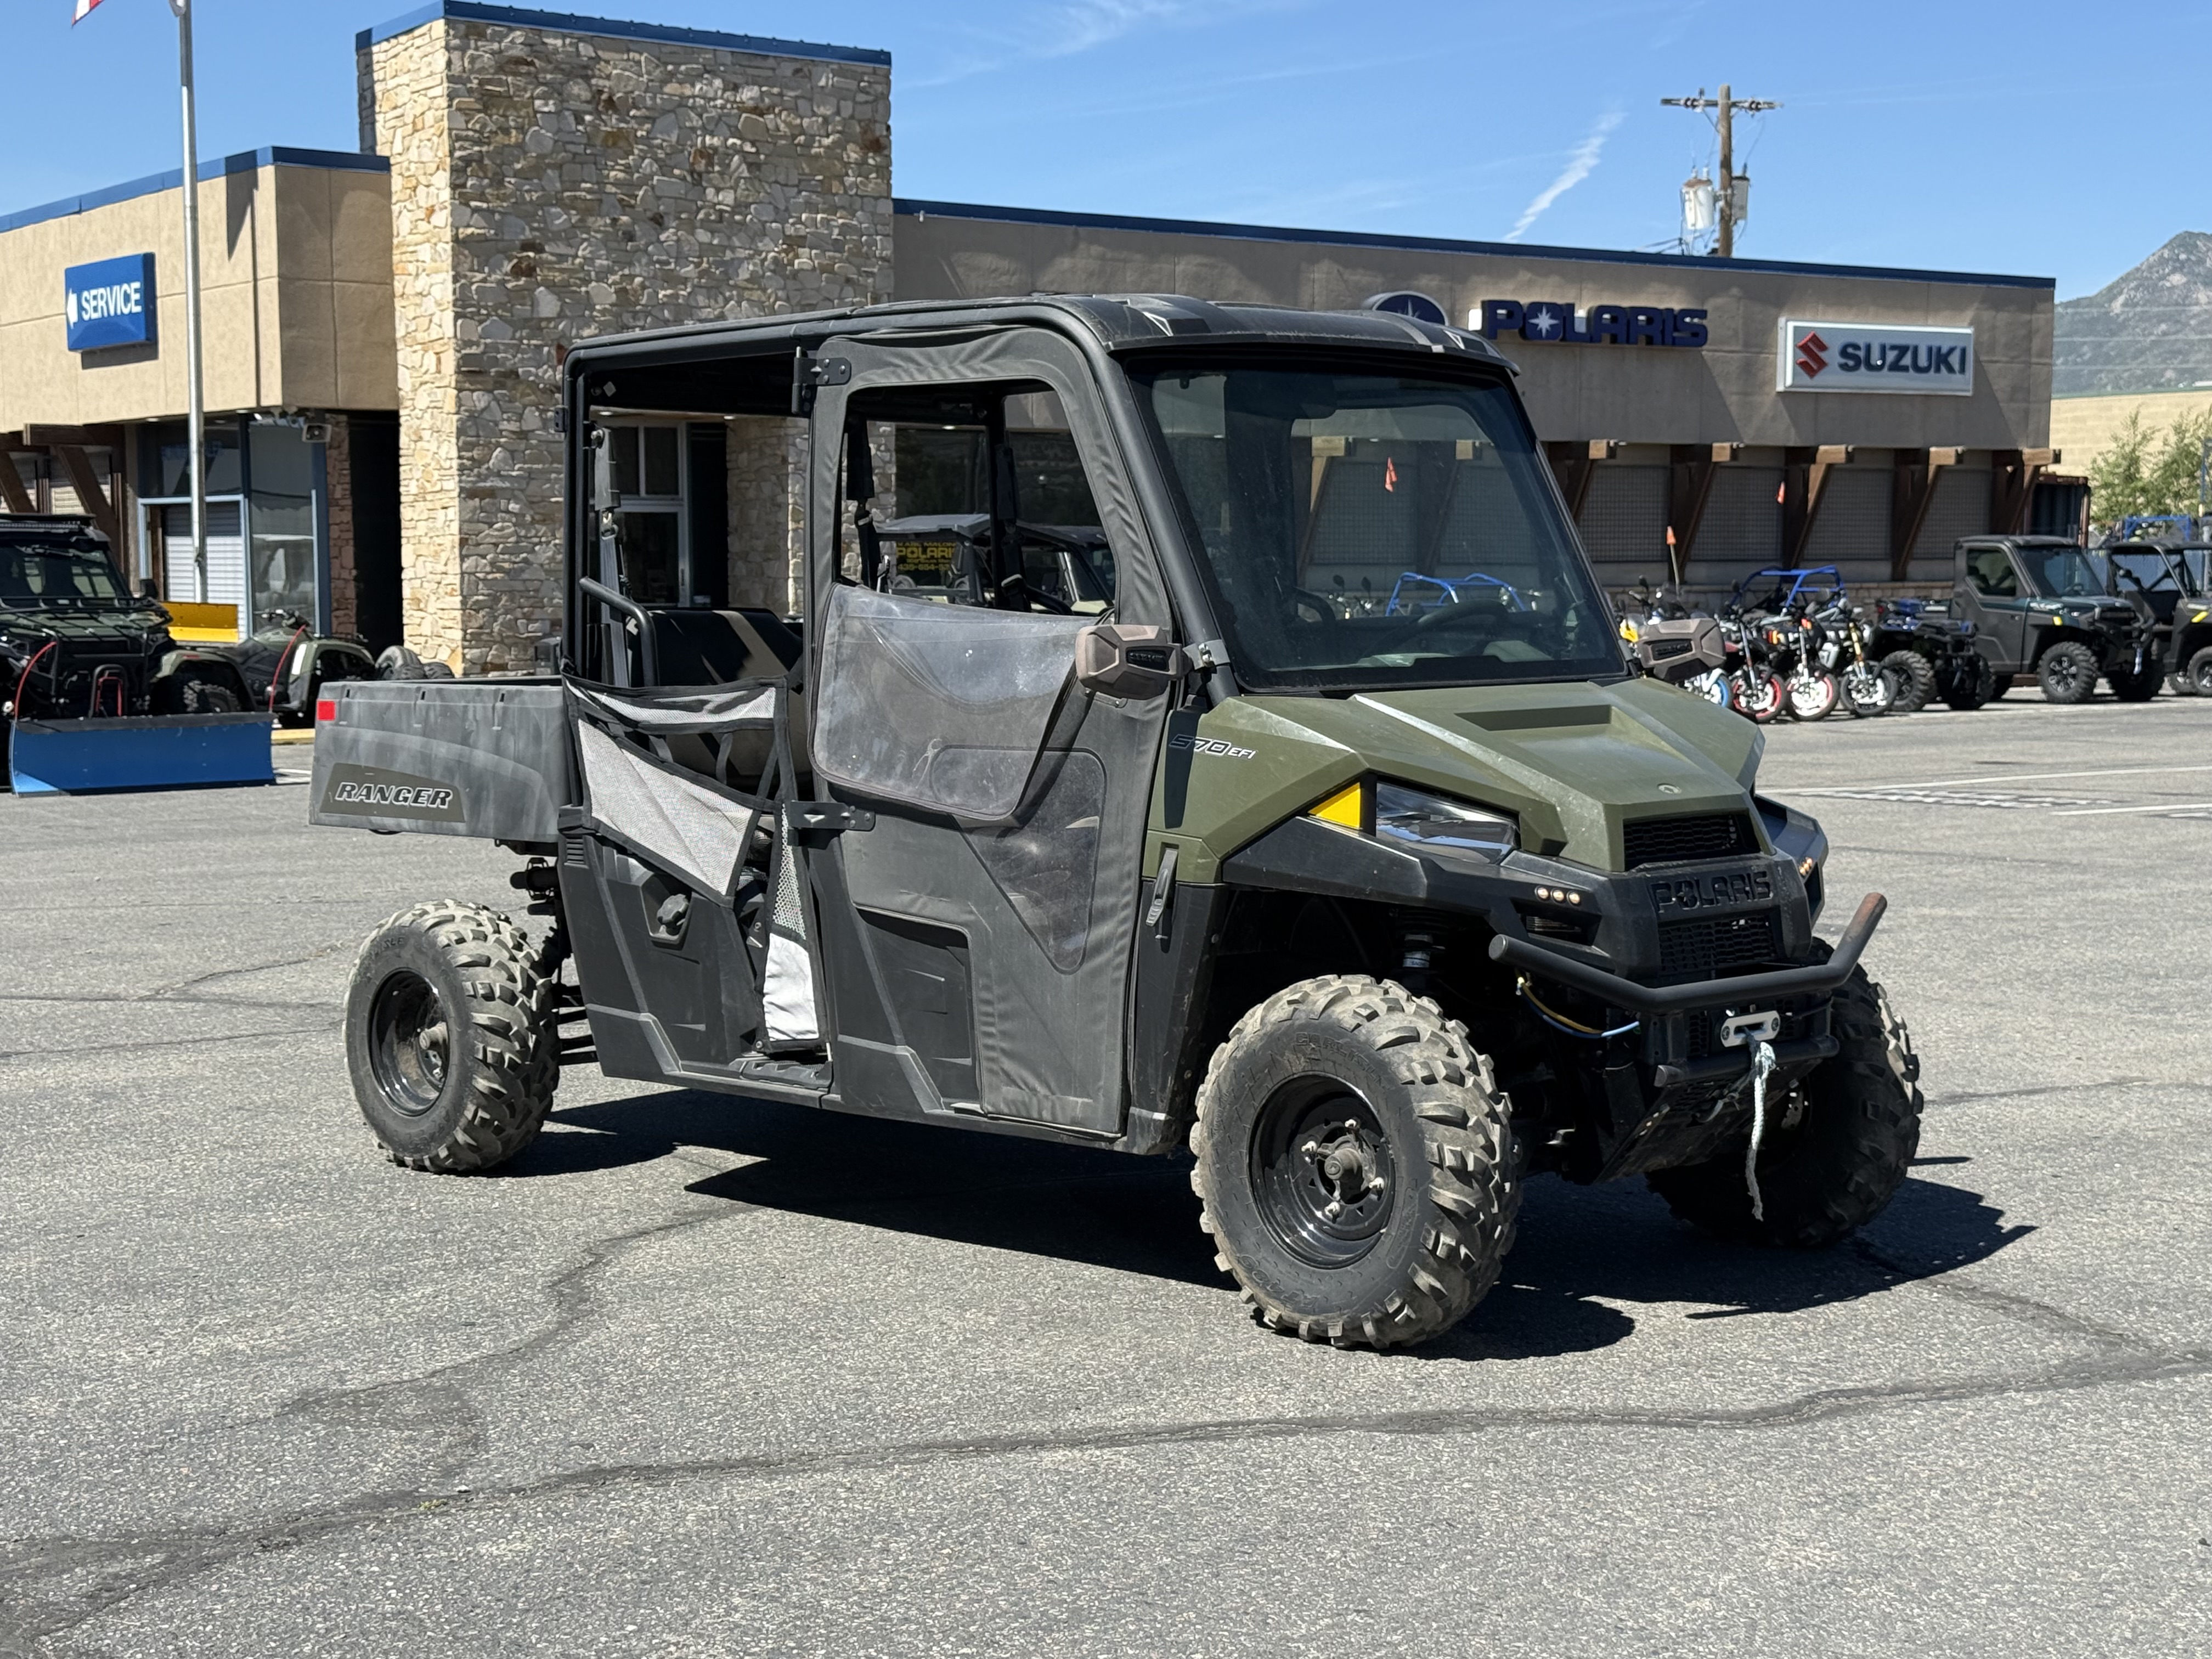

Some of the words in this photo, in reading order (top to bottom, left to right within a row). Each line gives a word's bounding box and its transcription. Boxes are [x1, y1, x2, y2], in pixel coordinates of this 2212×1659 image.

[81, 281, 142, 321] SERVICE
[1481, 300, 1708, 347] POLARIS
[1838, 341, 1967, 375] SUZUKI
[1169, 734, 1232, 756] 570
[1227, 747, 1256, 759] EFI
[335, 782, 453, 809] RANGER
[1647, 871, 1774, 913] POLARIS
